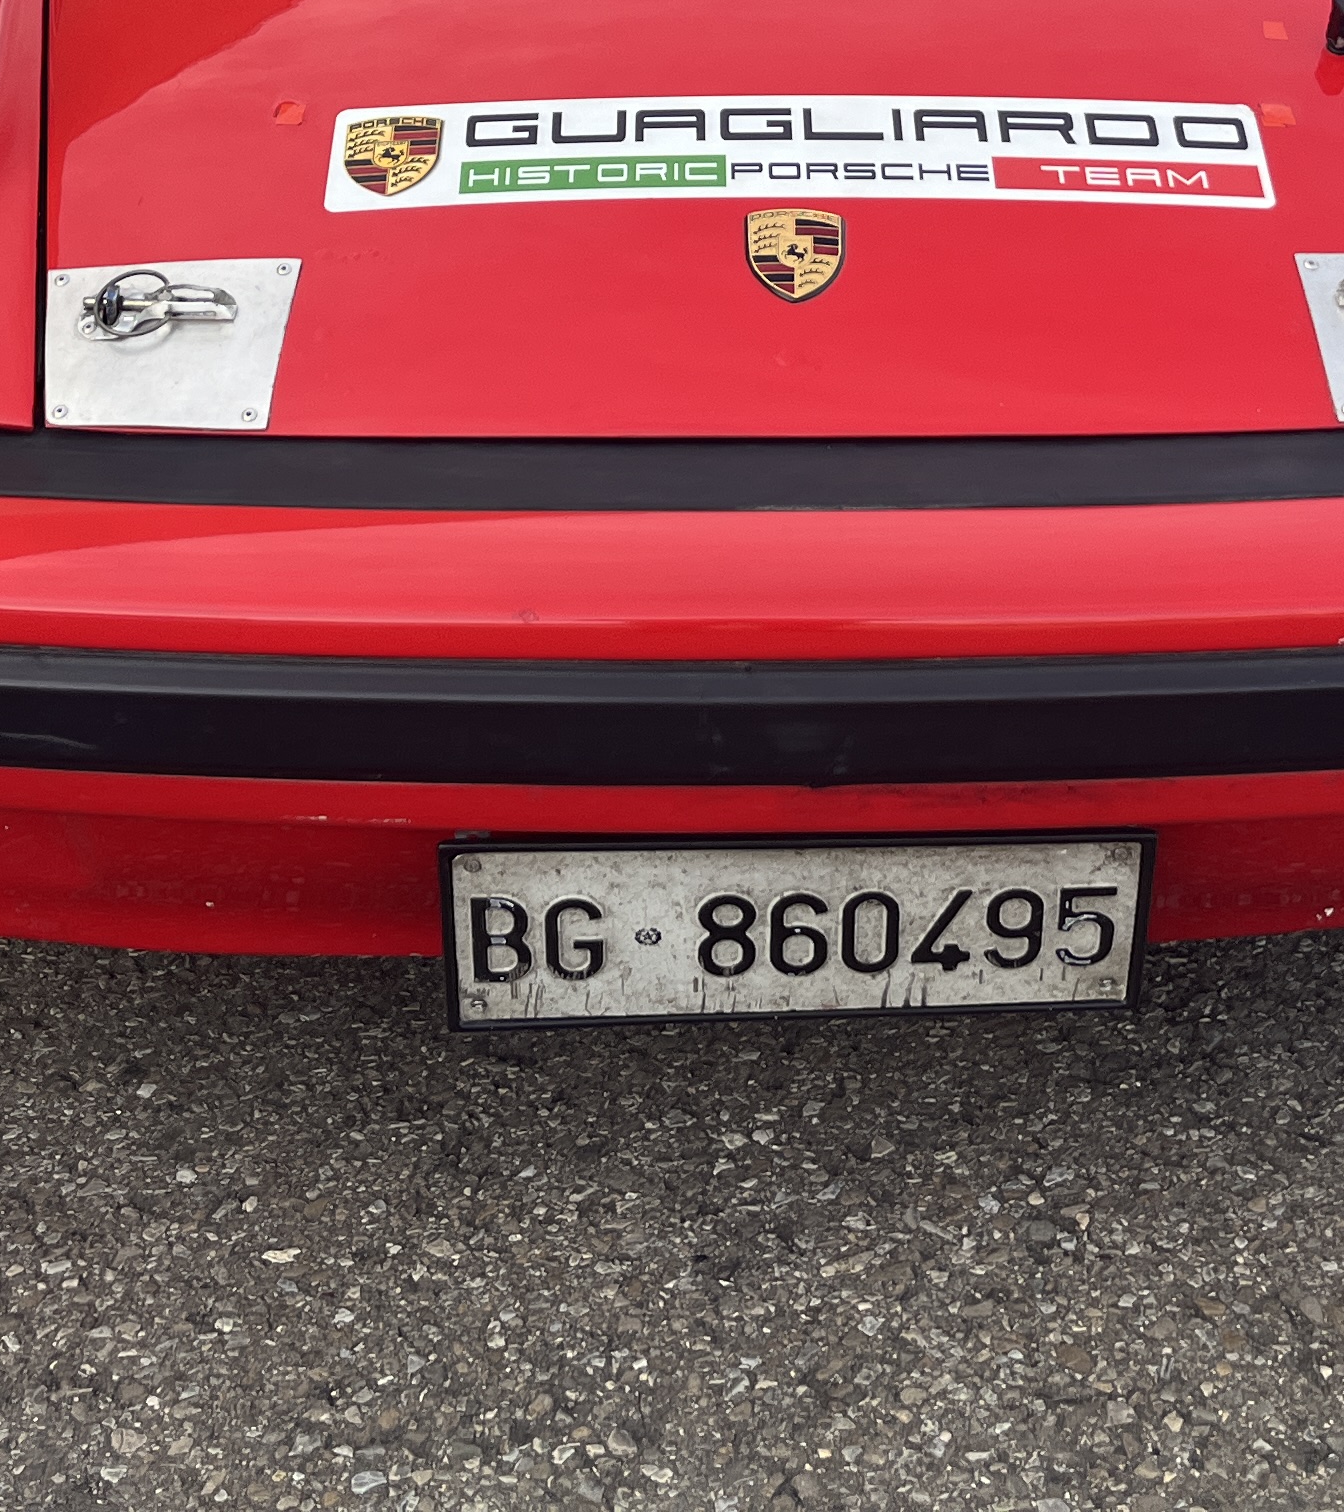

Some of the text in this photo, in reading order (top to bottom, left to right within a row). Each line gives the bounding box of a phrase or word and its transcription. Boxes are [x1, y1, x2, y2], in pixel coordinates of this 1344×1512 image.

[466, 107, 1249, 150] GUAGLIARDO
[467, 161, 1210, 189] HISTORIC PORSCHE TEAM
[470, 886, 1118, 983] BG 860495
